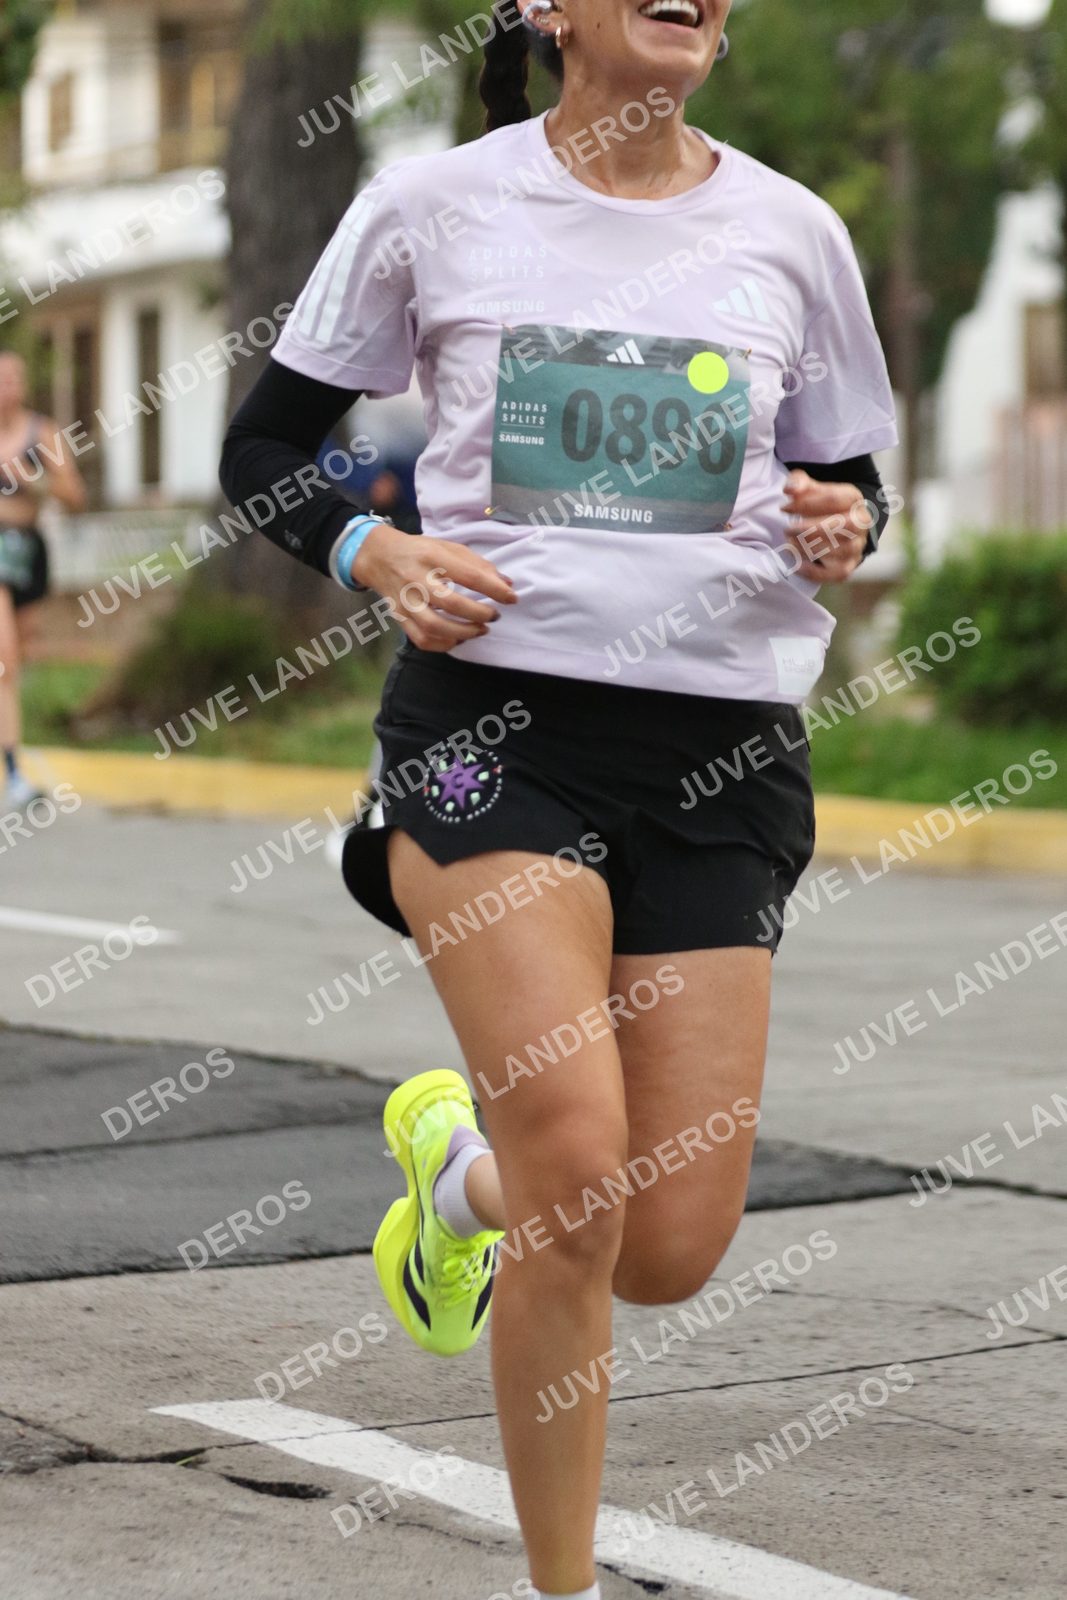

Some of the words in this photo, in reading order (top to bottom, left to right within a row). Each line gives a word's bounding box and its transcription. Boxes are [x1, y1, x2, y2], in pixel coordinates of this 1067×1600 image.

[468, 246, 546, 260] ADIDAS
[468, 265, 544, 281] SPLITS
[466, 300, 545, 314] SAMSUNG
[502, 400, 548, 413] ADIDAS
[502, 412, 546, 426] SPLITS
[499, 433, 545, 446] SAMSUNG
[574, 502, 654, 524] SAMSUNG
